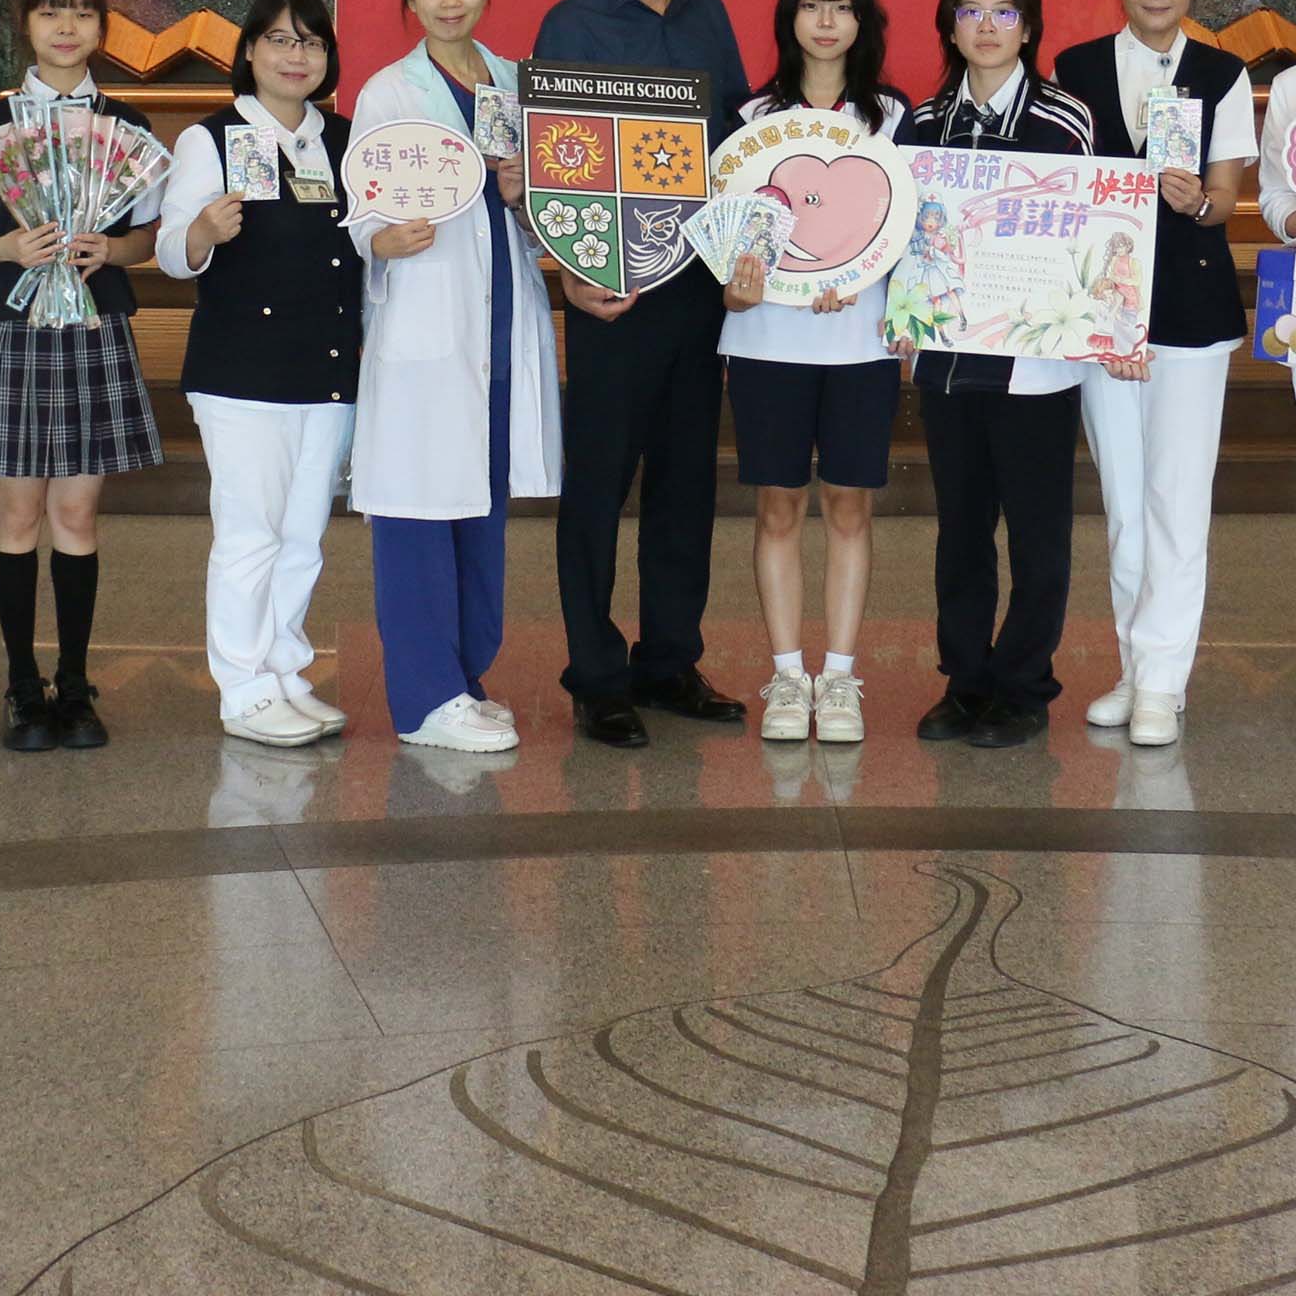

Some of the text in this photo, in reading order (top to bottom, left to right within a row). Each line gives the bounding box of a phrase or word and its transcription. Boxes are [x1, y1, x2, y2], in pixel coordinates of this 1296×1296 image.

[531, 75, 697, 101] TA-MING HIGH SCHOOL
[361, 142, 429, 173] 媽咪
[909, 150, 1157, 209] 母親節 快樂
[392, 185, 459, 208] 辛苦了
[994, 198, 1091, 238] 醫護節
